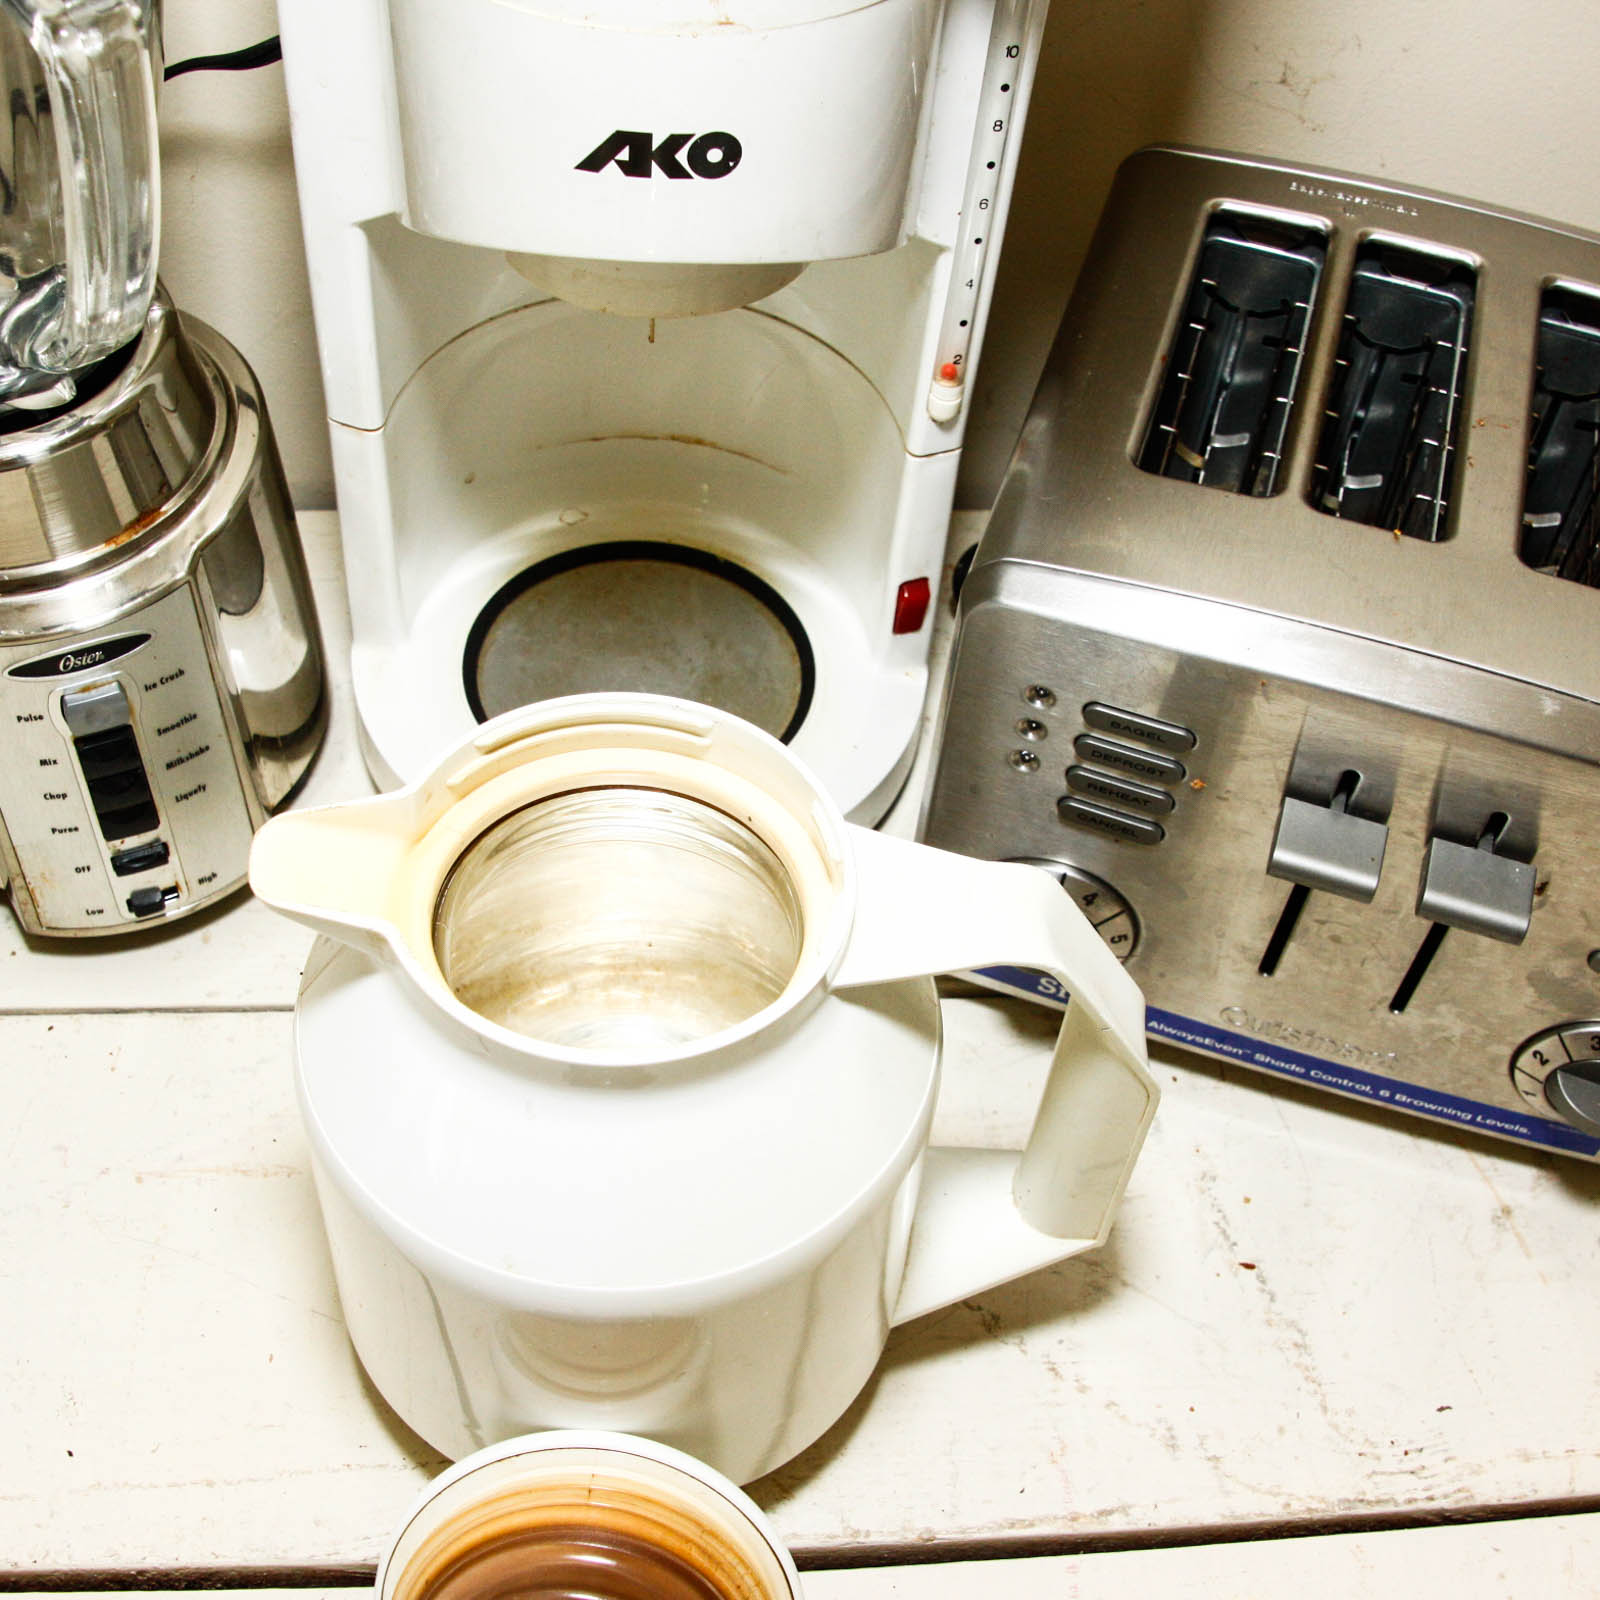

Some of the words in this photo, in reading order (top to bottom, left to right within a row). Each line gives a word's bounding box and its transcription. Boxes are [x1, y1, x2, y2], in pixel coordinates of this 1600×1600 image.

[1006, 45, 1019, 58] 10
[993, 120, 1003, 132] 8
[574, 130, 742, 179] AKO
[979, 198, 989, 209] 6
[966, 279, 974, 289] 4
[953, 354, 962, 365] 2
[59, 650, 103, 673] Oster
[144, 682, 158, 692] Ice
[160, 668, 185, 685] Crush
[16, 714, 44, 723] Pulse
[157, 713, 198, 736] Smoothie
[1110, 720, 1166, 743] BAGEL
[39, 759, 58, 767] Mix
[165, 745, 210, 771] Milkshake
[1091, 750, 1166, 777] DEFROST
[43, 792, 68, 800] Chop
[1087, 782, 1151, 807] REHEAT
[1077, 812, 1136, 838] CANCEL
[198, 872, 217, 885] High
[1082, 892, 1099, 907] 4
[85, 908, 104, 916] Low
[1110, 933, 1129, 945] 5
[1532, 1049, 1550, 1067] 2
[1253, 1052, 1307, 1075] Shade
[1309, 1069, 1374, 1094] Control,
[1379, 1089, 1391, 1098] 6
[1394, 1093, 1473, 1121] Browning
[1475, 1114, 1532, 1136] Levels.
[1522, 1089, 1537, 1097] 1
